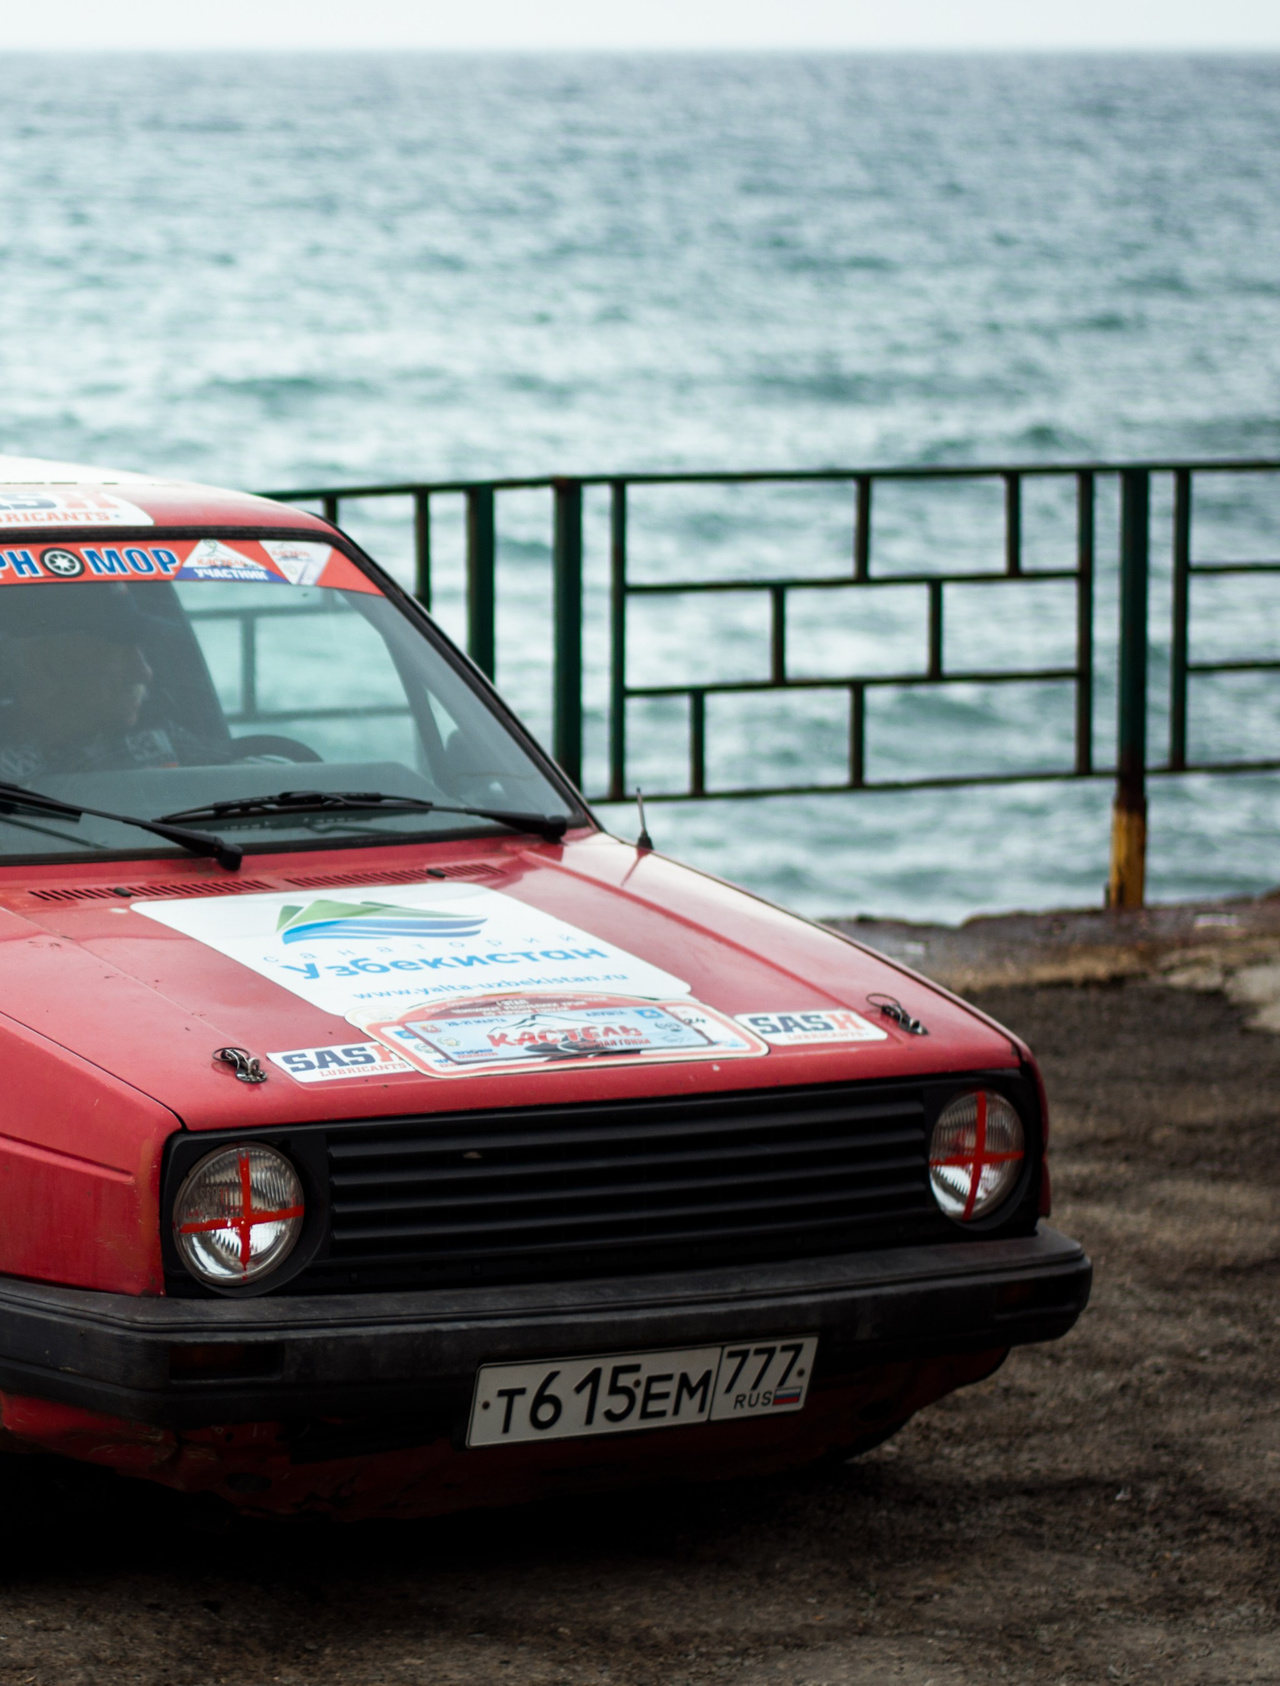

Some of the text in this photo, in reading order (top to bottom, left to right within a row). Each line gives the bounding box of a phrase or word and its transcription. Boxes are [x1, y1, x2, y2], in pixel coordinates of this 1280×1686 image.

[194, 568, 269, 581] УЧАСТНИК
[280, 948, 609, 980] Узбекистан
[352, 972, 630, 999] www.yalta-uzbekistan.ru
[748, 1013, 865, 1034] SASH
[487, 1025, 643, 1047] КАСТЕЛЬ
[319, 1062, 407, 1077] LUBRICANTS
[724, 1343, 805, 1395] 777
[733, 1391, 773, 1410] RUS
